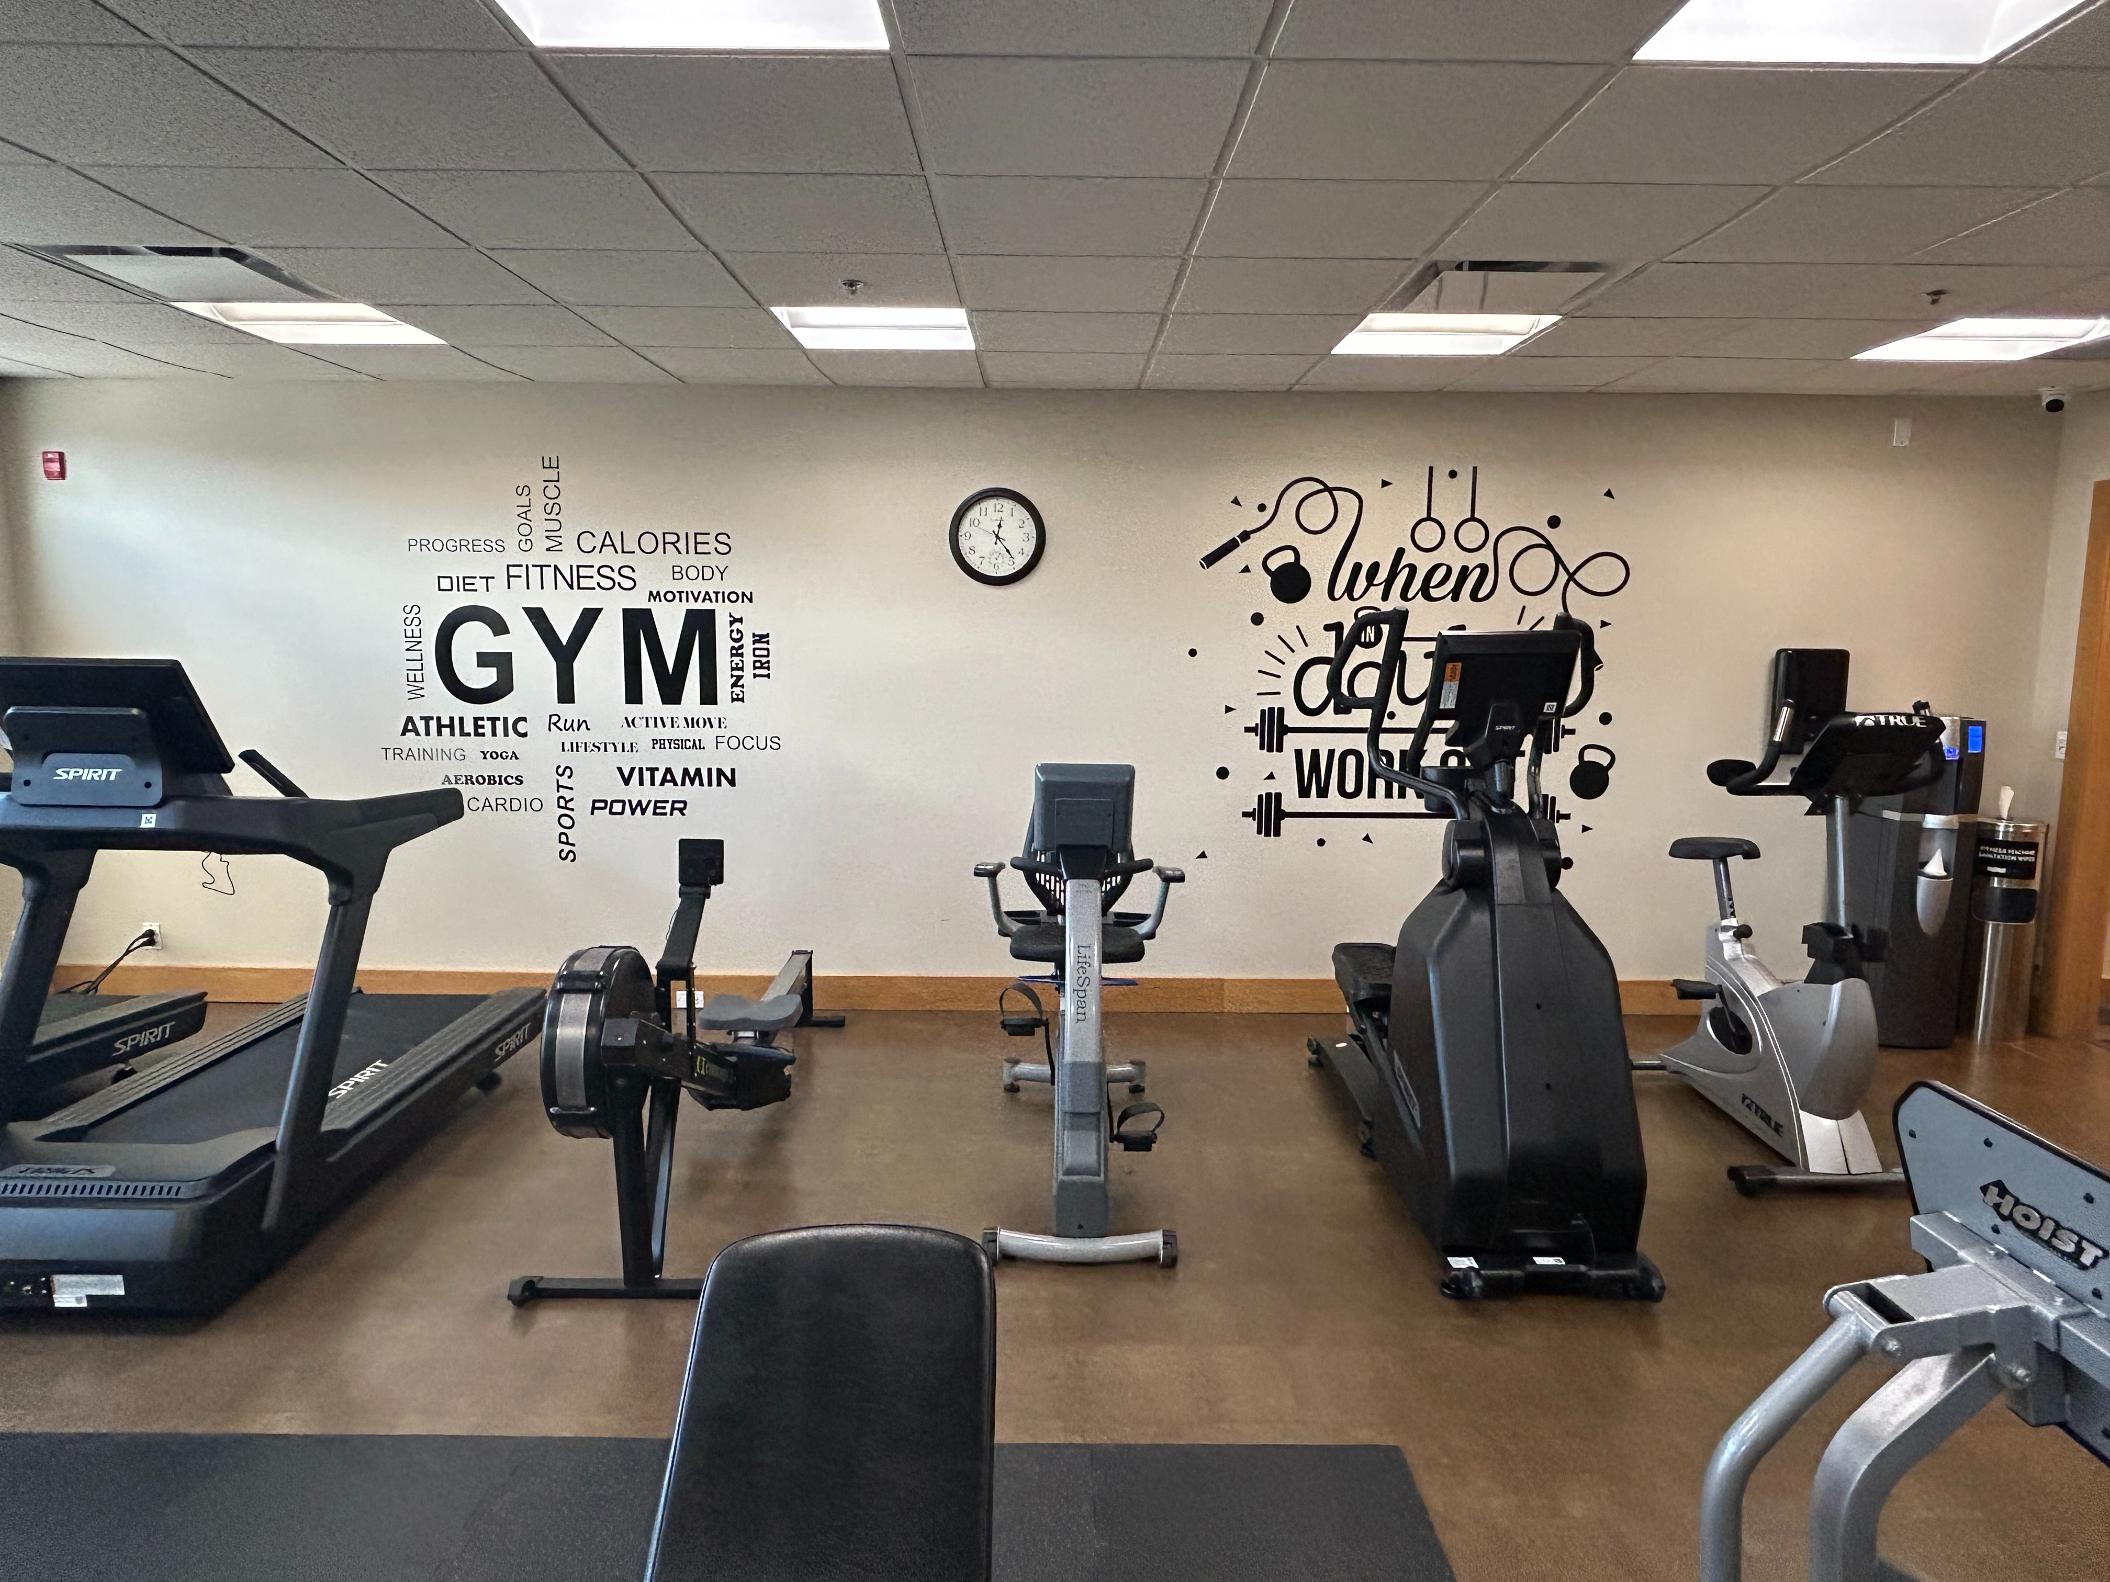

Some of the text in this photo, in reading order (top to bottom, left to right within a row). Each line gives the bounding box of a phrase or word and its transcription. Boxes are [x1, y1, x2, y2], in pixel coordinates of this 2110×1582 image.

[542, 456, 563, 551] MUSCLE
[994, 503, 1004, 513] 12
[516, 485, 533, 552] GOALS
[979, 507, 988, 517] 11
[969, 518, 981, 528] 10
[1018, 519, 1025, 529] 2
[577, 531, 731, 555] CALORIES
[964, 531, 972, 541] 9
[1022, 532, 1030, 542] 3
[408, 539, 505, 552] PROGRESS
[968, 546, 976, 555] 8
[1018, 547, 1025, 556] 4
[978, 556, 985, 566] 7
[507, 564, 636, 591] FITNESS
[672, 565, 728, 581] BODY
[1328, 547, 1494, 602] when
[438, 576, 495, 592] DIET
[648, 591, 753, 603] MOTIVATION
[1360, 625, 1375, 643] IN
[403, 605, 424, 700] WELLNESS
[435, 605, 718, 705] GYM
[729, 612, 744, 703] ENERGY
[752, 633, 770, 679] IRON
[400, 716, 528, 738] ATHLETIC
[548, 714, 590, 732] Run
[622, 717, 727, 728] ACTIVE MOVE
[1876, 714, 1927, 728] TRUE
[562, 742, 638, 752] LIFESTYLE
[652, 739, 705, 750] PHYSICAL
[716, 736, 781, 750] FOCUS
[381, 748, 465, 761] TRAINING
[480, 751, 519, 760] YOGA
[53, 767, 123, 780] SPIRIT
[442, 775, 523, 785] AEROBICS
[616, 767, 736, 787] VITAMIN
[468, 797, 543, 812] CARDIO
[591, 799, 687, 816] POWER
[556, 765, 576, 862] SPORTS
[1073, 944, 1092, 1024] LifeSpan
[112, 1021, 176, 1056] SPIRIT
[494, 1023, 533, 1062] SPIRIT
[328, 1059, 389, 1099] SPIRIT
[1983, 1184, 2103, 1267] HOIST
